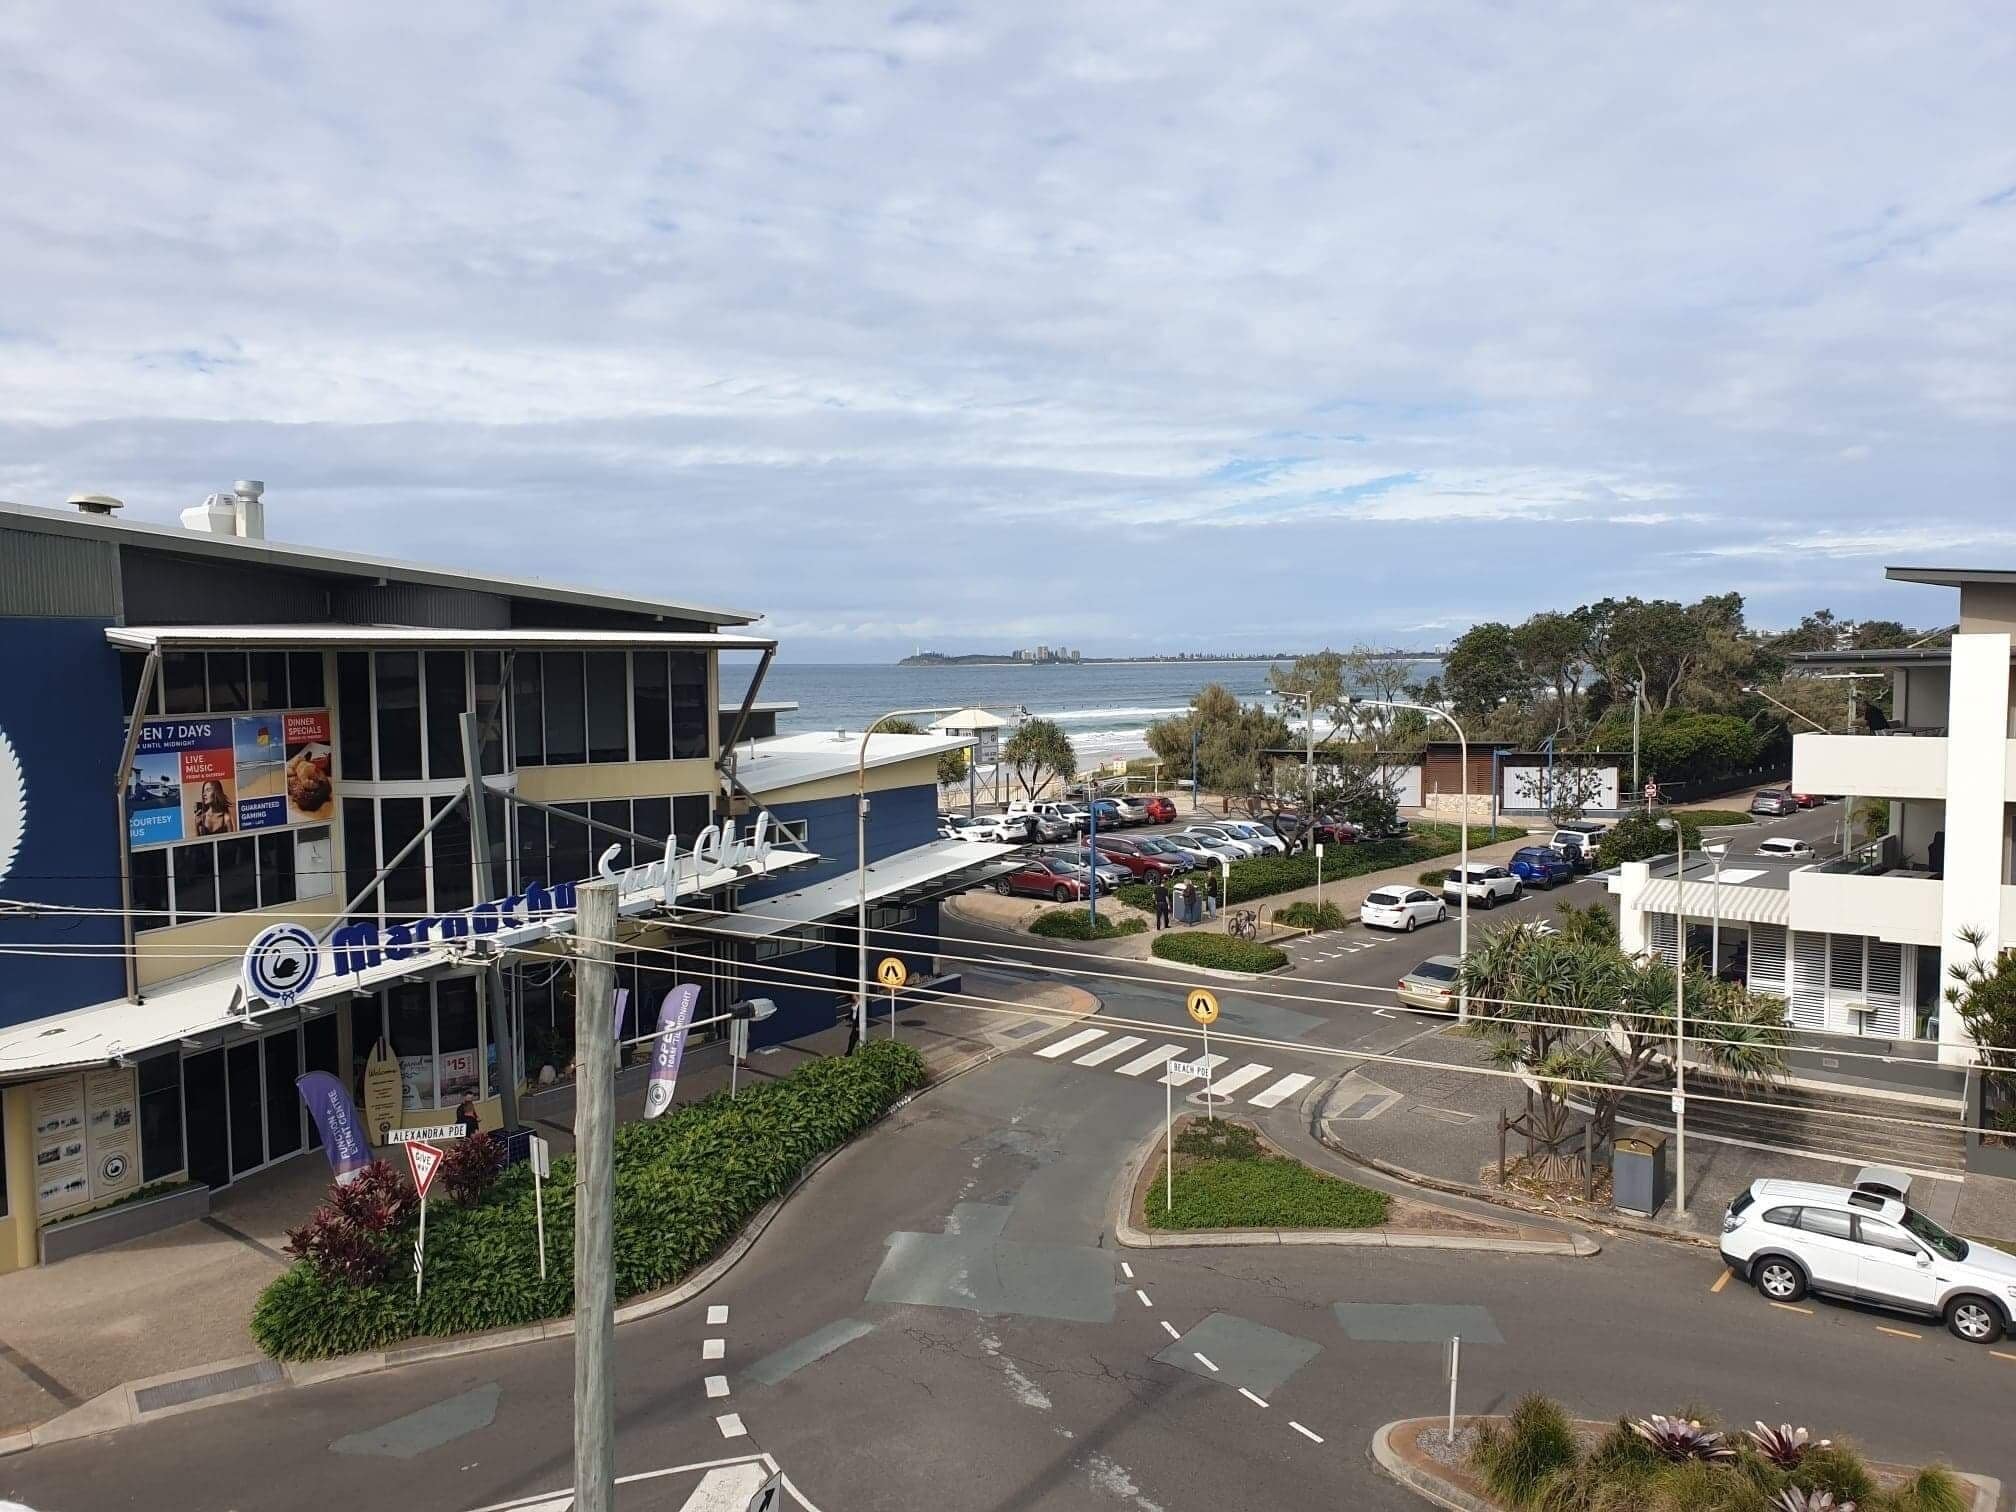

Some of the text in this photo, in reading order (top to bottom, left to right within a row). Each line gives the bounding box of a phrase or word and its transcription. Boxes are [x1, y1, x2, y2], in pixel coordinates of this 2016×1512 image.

[287, 717, 315, 727] DINNER
[166, 726, 175, 739] 7
[179, 724, 211, 739] DAYS
[288, 725, 322, 736] SPECIALS
[164, 740, 195, 748] MIDNIGHT
[185, 754, 205, 764] LIVE
[185, 763, 213, 774] MUSIC
[240, 801, 280, 812] GUARANTEED
[241, 811, 267, 820] GAMING
[598, 843, 680, 905] Surf
[693, 811, 771, 876] Club
[658, 1020, 676, 1066] OPEN
[447, 1057, 466, 1071] $15
[1173, 1062, 1209, 1077] BEACH PDE
[328, 1088, 358, 1155] EVENT CENTRE
[327, 1115, 351, 1160] FUNCTION
[393, 1124, 465, 1141] ALEXANDRA PDE
[415, 1151, 432, 1166] GIVE
